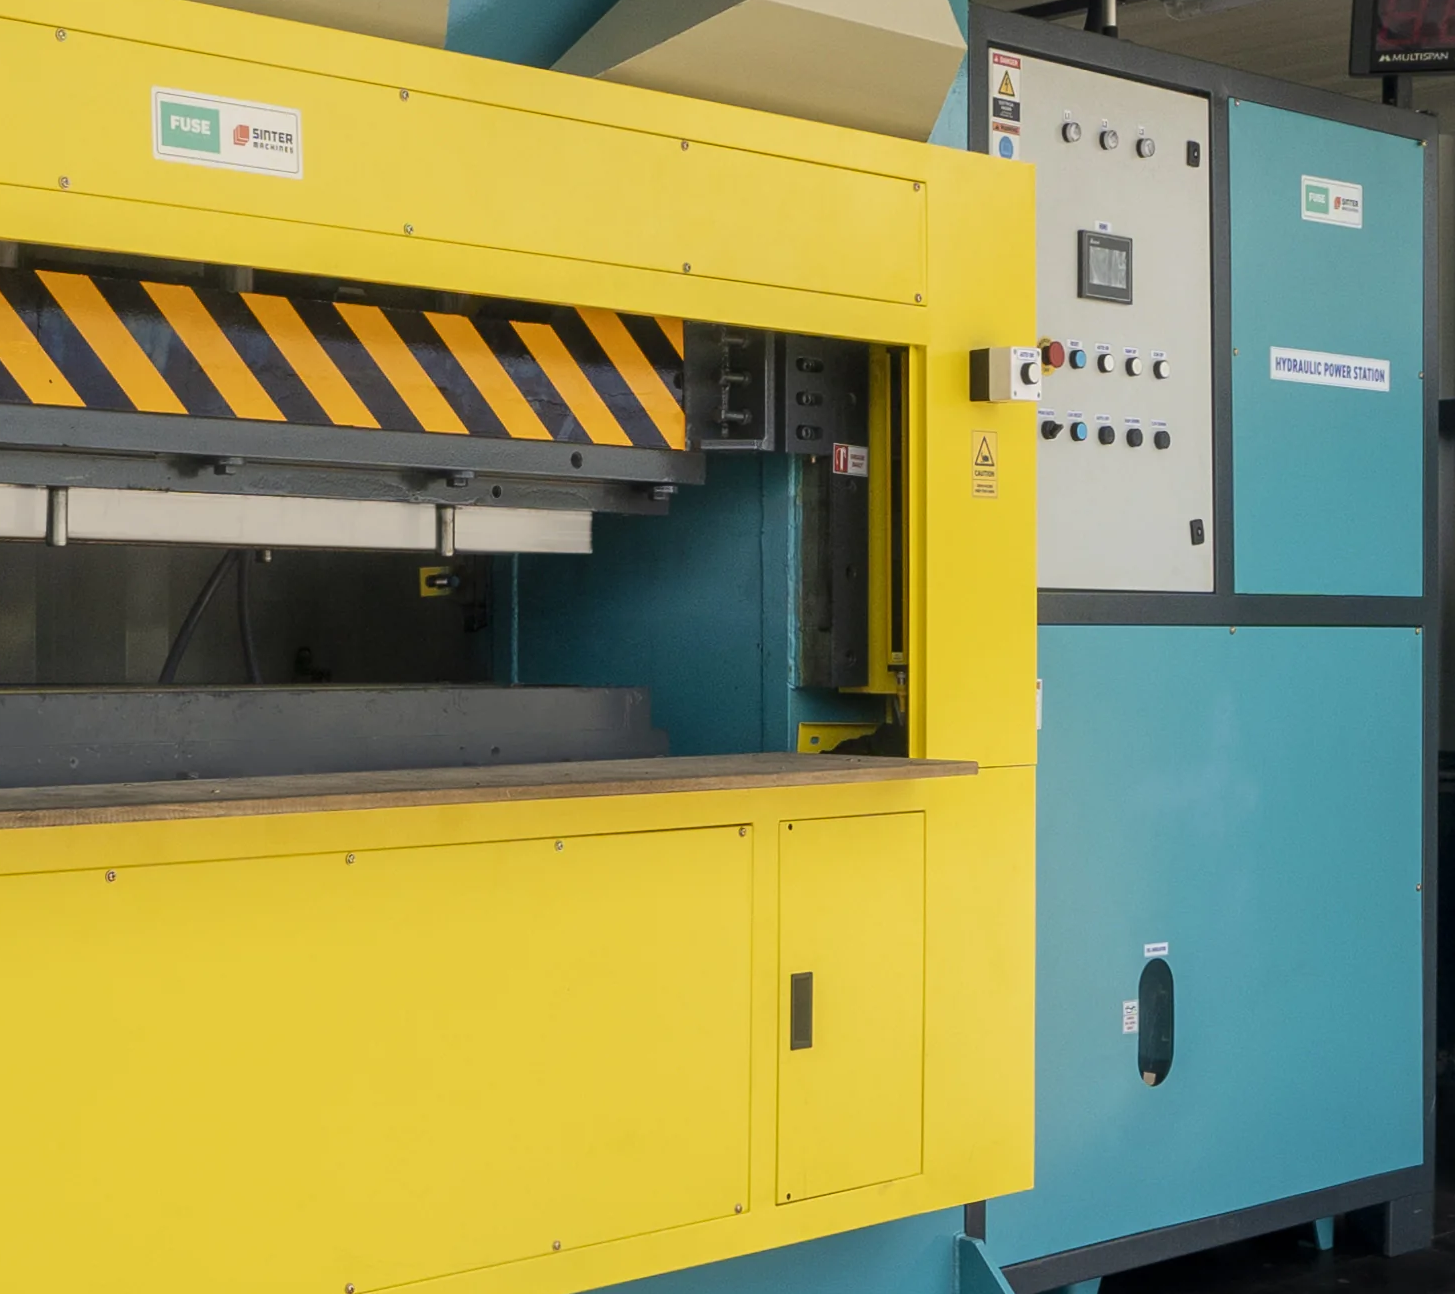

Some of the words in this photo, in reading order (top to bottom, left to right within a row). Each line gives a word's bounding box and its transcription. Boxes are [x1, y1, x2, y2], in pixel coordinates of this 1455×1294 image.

[1392, 52, 1449, 61] MULTISPAN
[170, 115, 211, 135] FUSE
[252, 128, 293, 145] SINTER
[253, 141, 294, 154] MACHINES
[1275, 356, 1322, 376] HYDRAULIC
[1323, 362, 1352, 379] POWER
[1353, 366, 1386, 383] STATION
